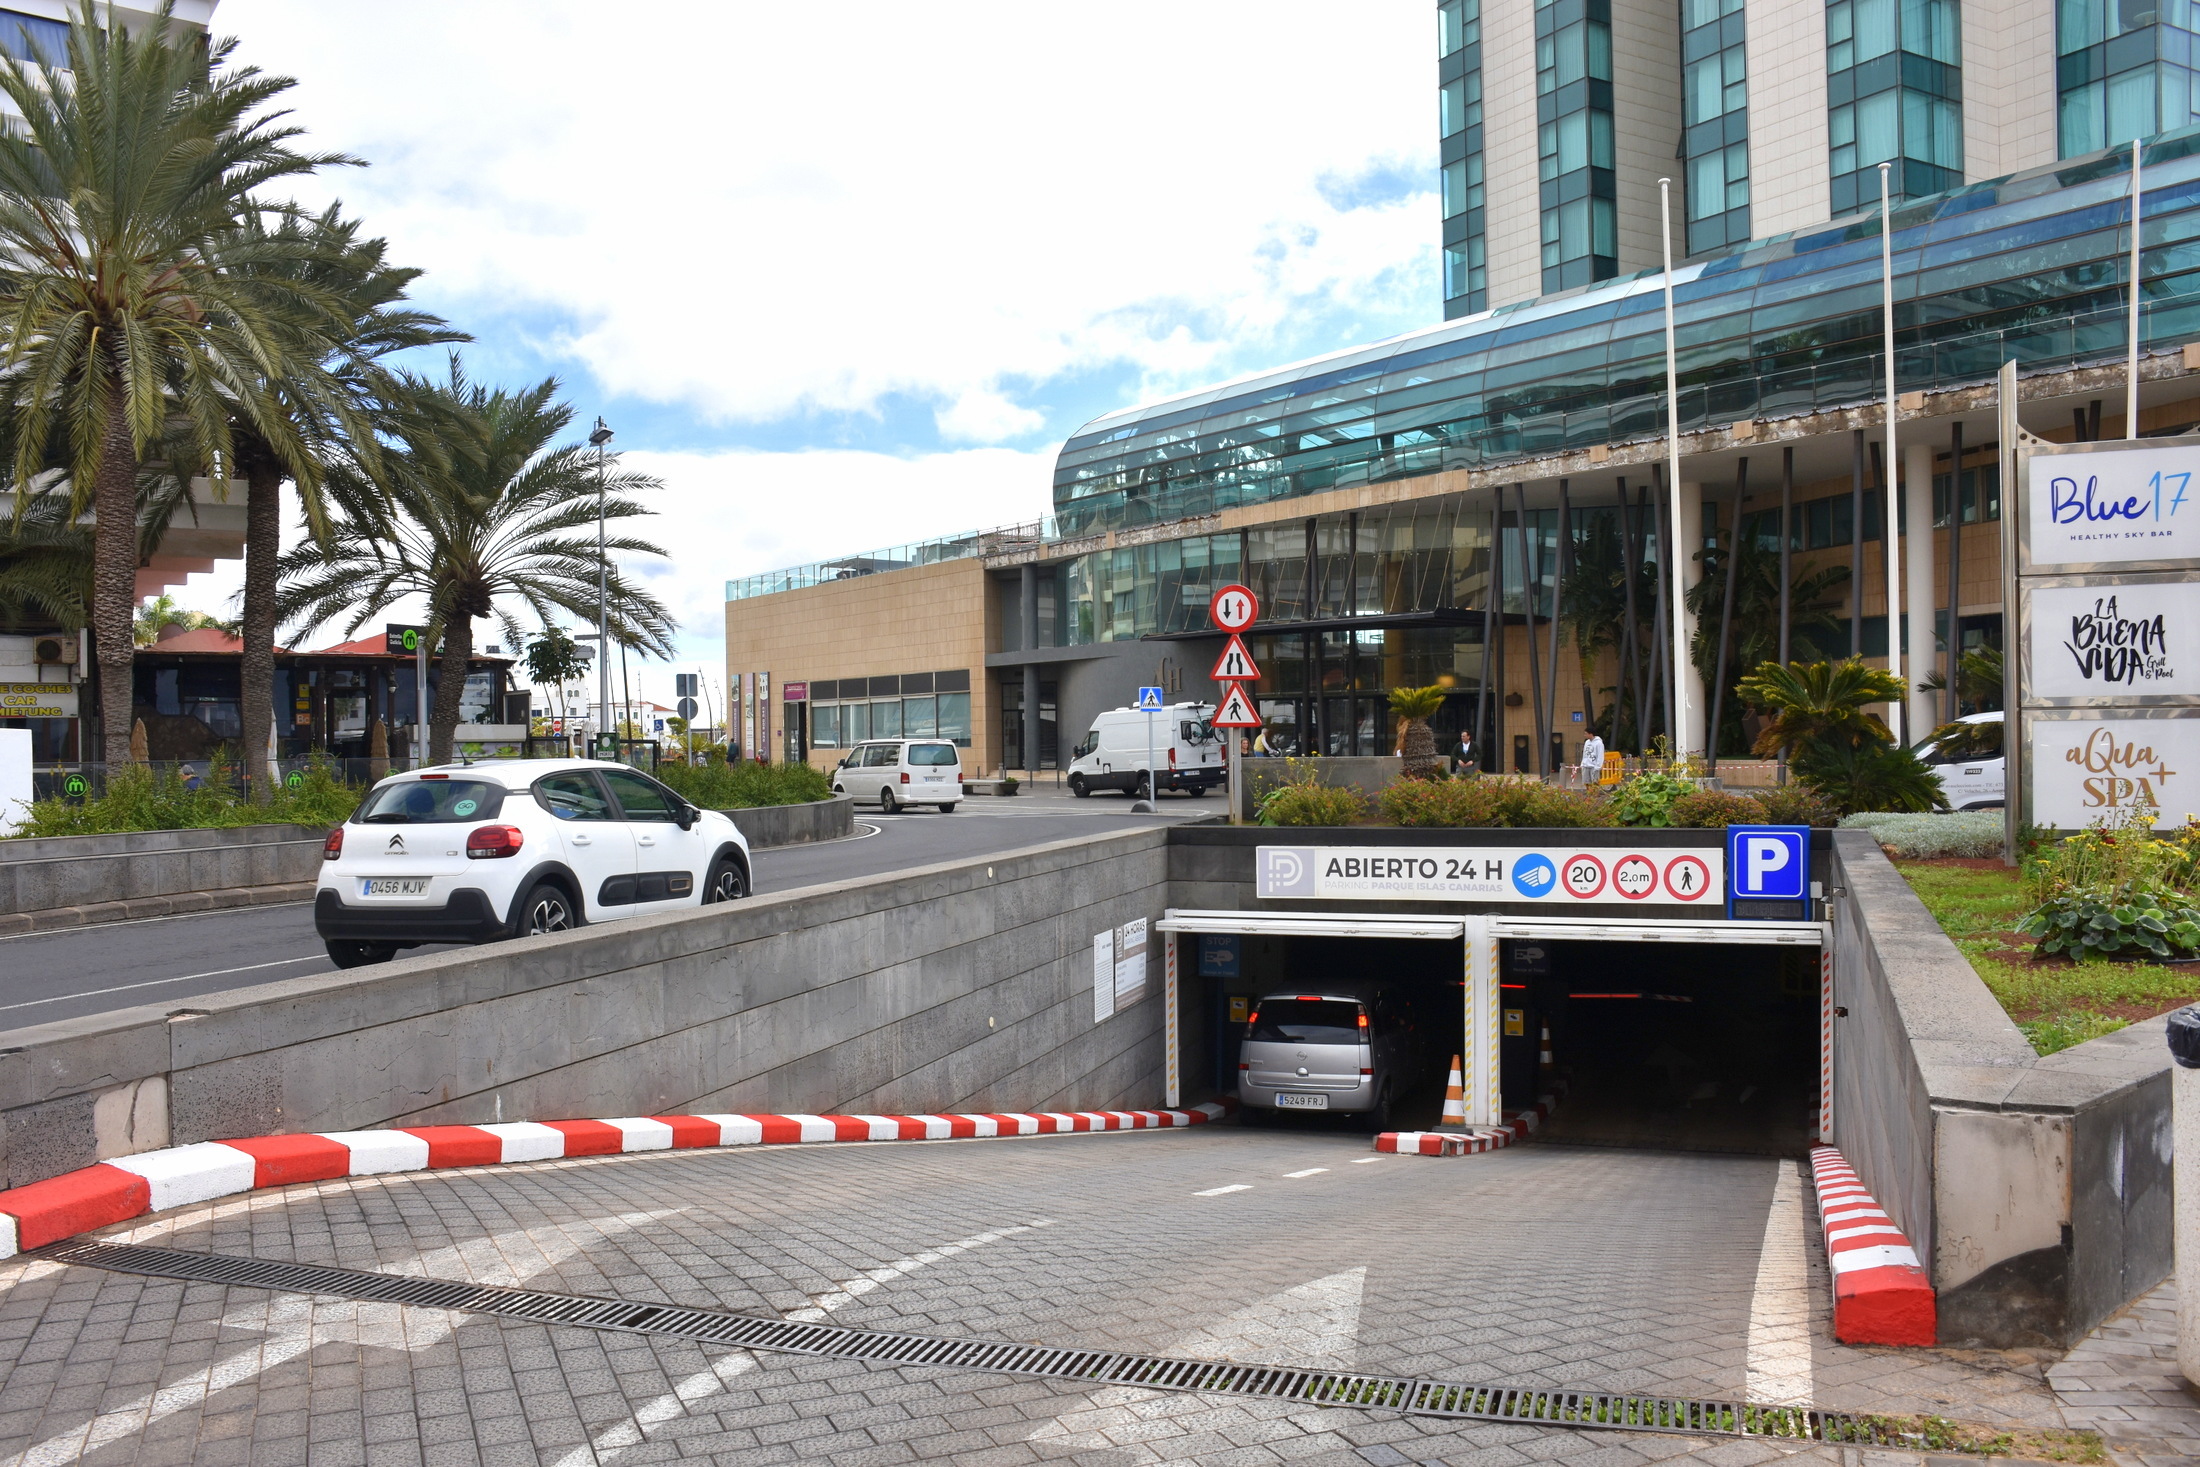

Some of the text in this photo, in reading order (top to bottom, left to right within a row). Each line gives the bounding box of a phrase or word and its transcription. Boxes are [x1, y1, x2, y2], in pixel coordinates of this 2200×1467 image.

[2051, 470, 2192, 524] Blue17
[2070, 533, 2119, 541] HEALTHY
[2094, 595, 2118, 621] LA
[2146, 655, 2166, 672] Grill
[2155, 668, 2174, 680] Pool
[12, 684, 73, 694] COCHES
[4, 695, 38, 706] CAR
[1574, 713, 1581, 721] H
[1325, 857, 1503, 880] ABIERTO 24 H
[1747, 838, 1790, 891] P
[1572, 866, 1597, 883] 20
[370, 881, 425, 894] 0456 MJV
[1324, 880, 1503, 892] PARKING PARQUE ISLAS CANARIAS
[1125, 920, 1146, 937] 24 HORAS
[1206, 937, 1232, 945] STOP
[1284, 1096, 1324, 1106] 5249 FRJ
